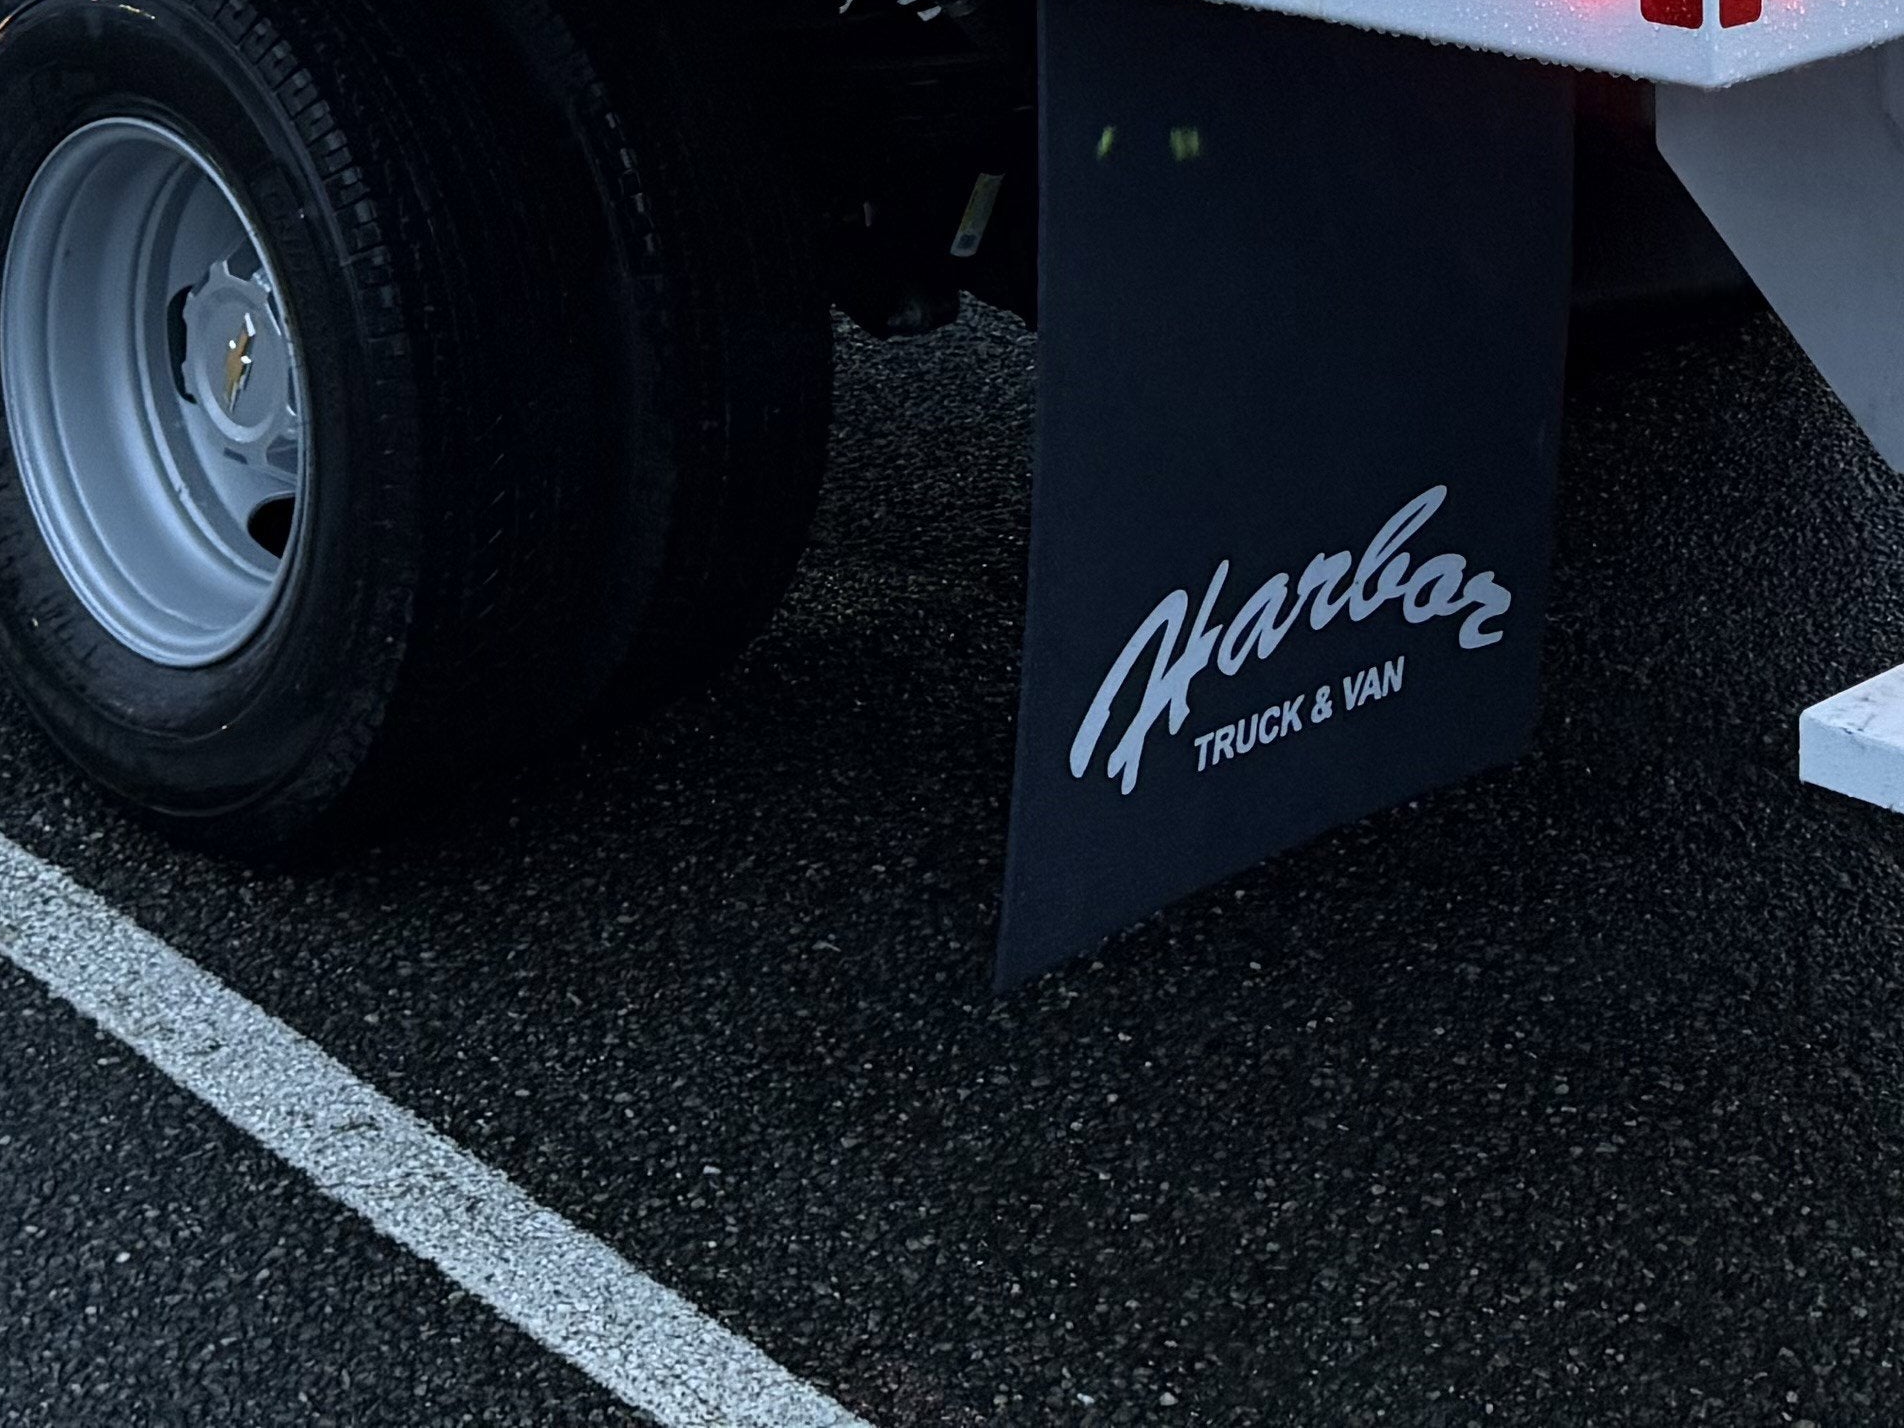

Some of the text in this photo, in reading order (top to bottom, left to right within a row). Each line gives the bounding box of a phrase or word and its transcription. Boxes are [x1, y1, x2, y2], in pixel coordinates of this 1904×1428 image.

[1069, 485, 1512, 795] Harbor
[1194, 656, 1405, 771] TRUCK & VAN
